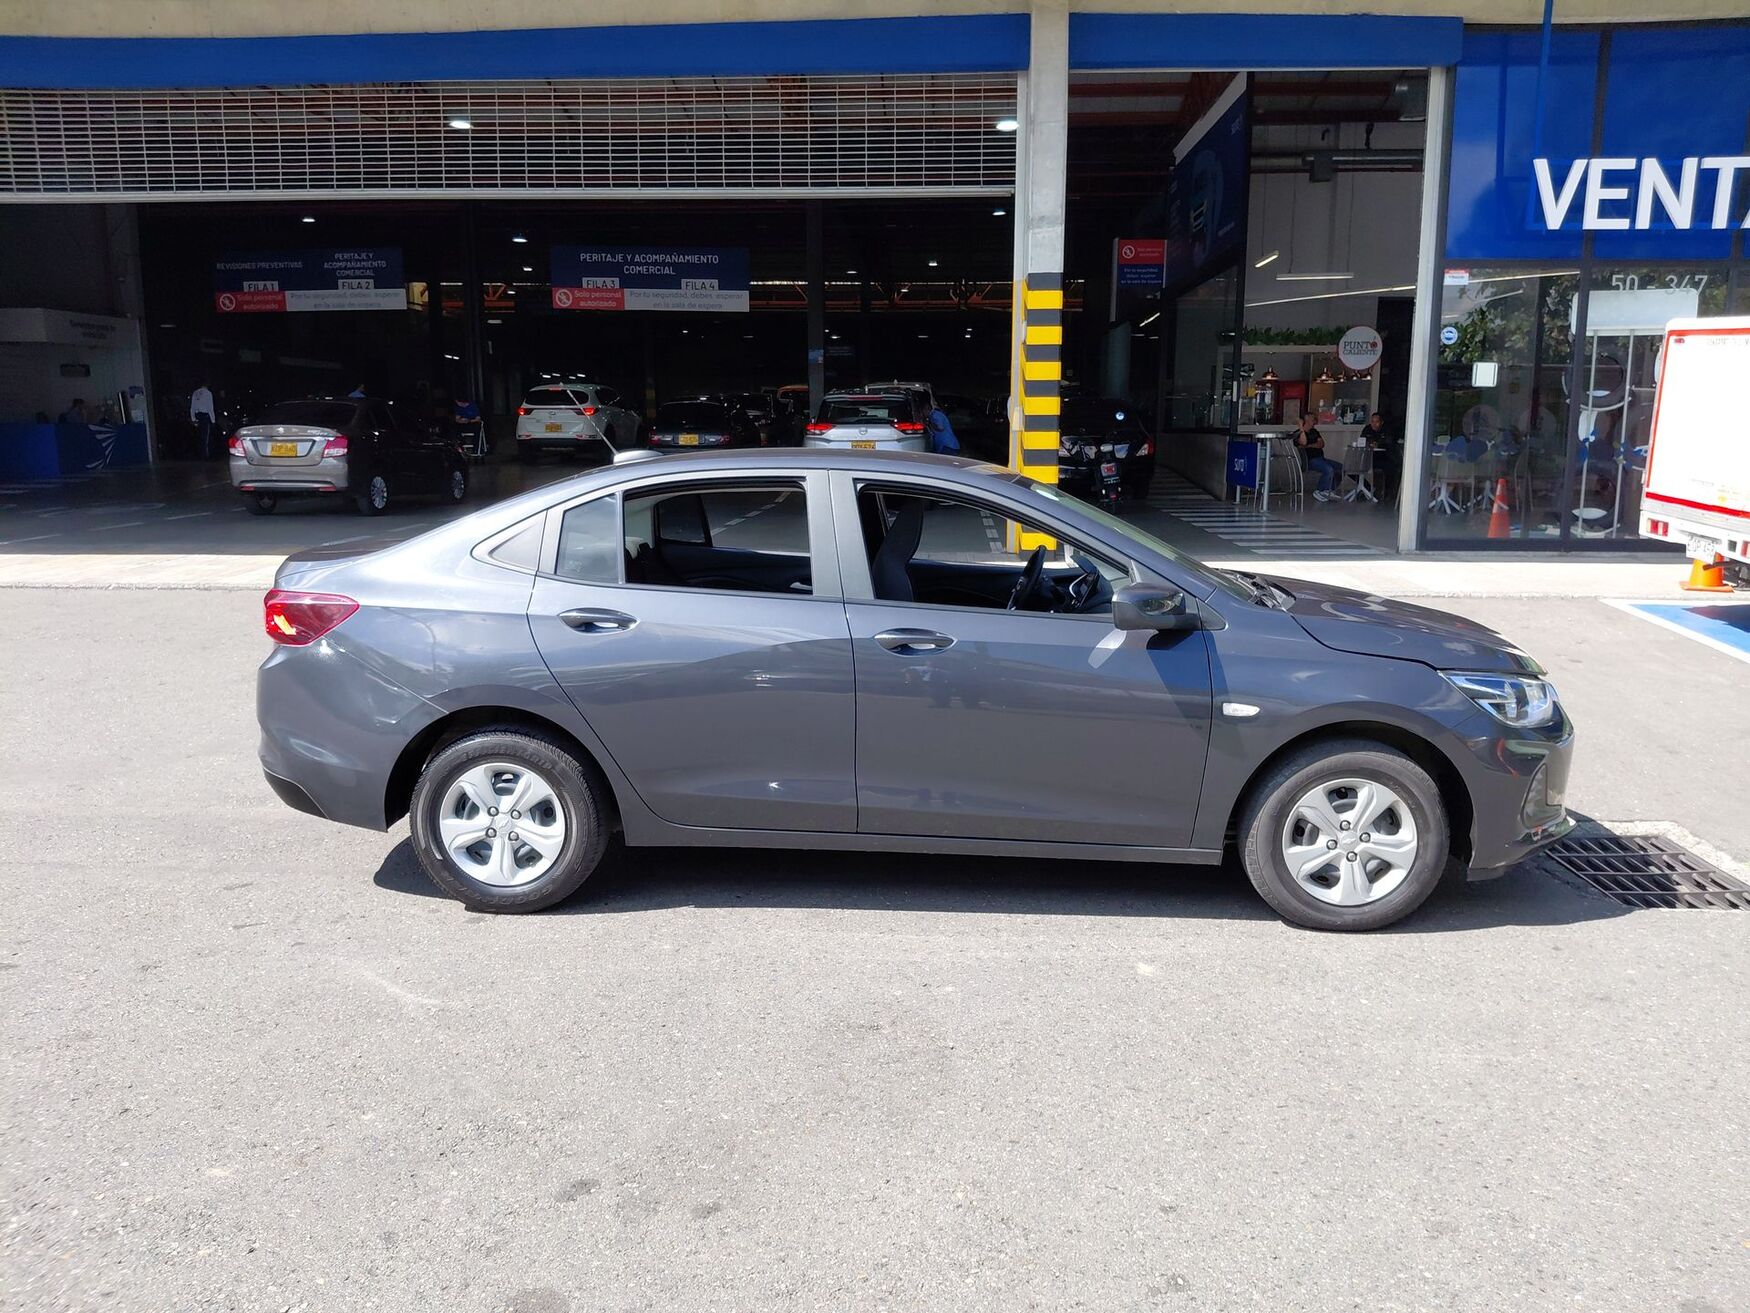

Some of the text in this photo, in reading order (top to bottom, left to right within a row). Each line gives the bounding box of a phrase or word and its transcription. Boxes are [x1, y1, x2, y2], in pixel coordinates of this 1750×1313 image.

[1533, 157, 1750, 230] VENT
[580, 252, 719, 264] PERITAJE Y ACOMPAÑAMIENTO
[624, 265, 676, 275] COMERCIAL
[247, 283, 269, 291] FILA
[341, 281, 363, 290] FILA
[586, 279, 608, 289] FILA
[685, 281, 707, 290] FILA
